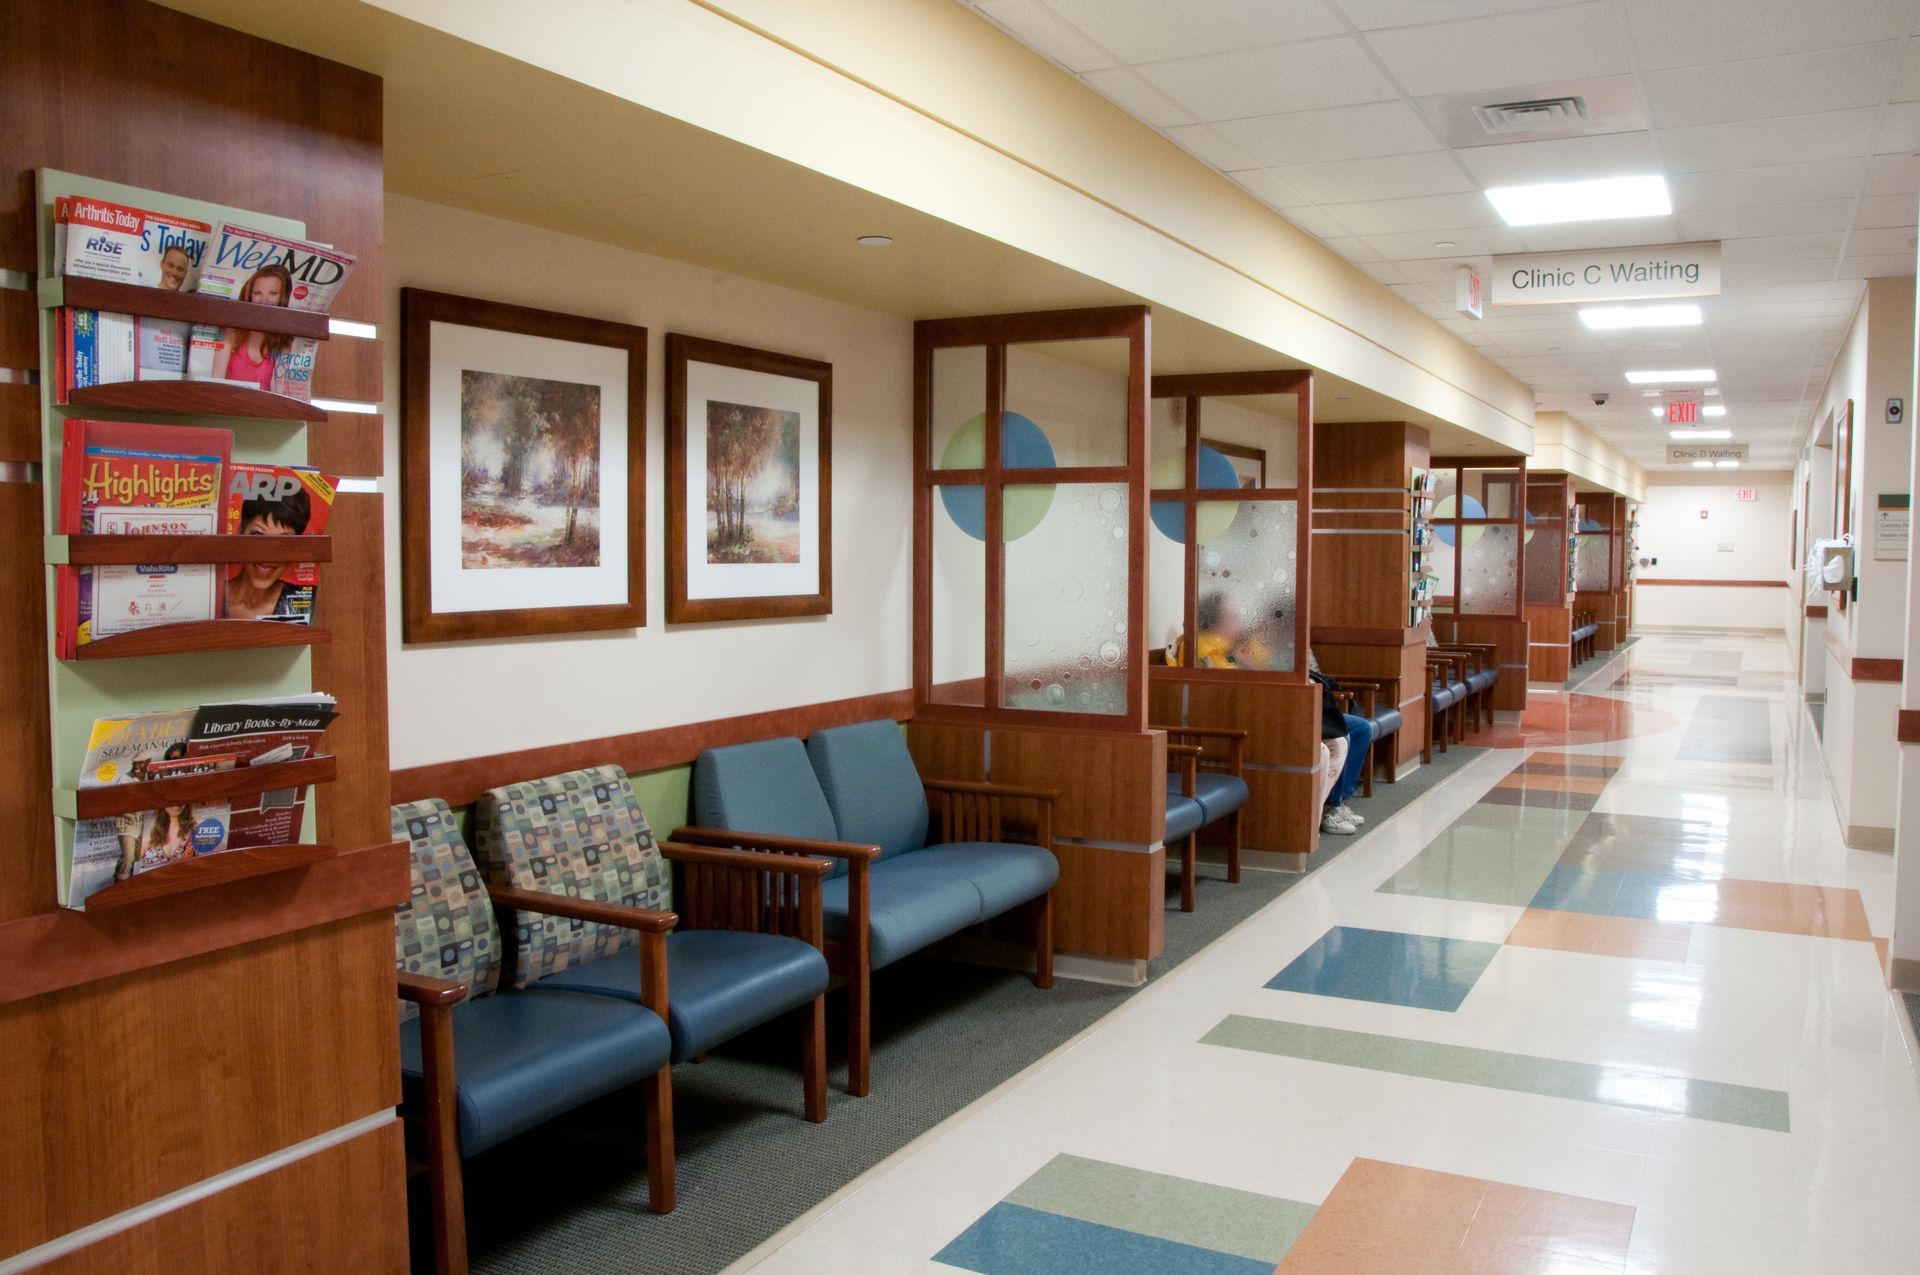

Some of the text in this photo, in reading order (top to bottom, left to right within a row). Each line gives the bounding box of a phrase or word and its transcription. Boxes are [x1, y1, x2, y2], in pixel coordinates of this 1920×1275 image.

[74, 201, 140, 233] Arthritis Today
[157, 224, 206, 268] Today
[215, 232, 345, 286] WebMD
[1511, 260, 1700, 290] Clinic C Waiting
[271, 348, 312, 368] Marcia
[274, 364, 309, 382] Cross
[1669, 401, 1697, 424] EXIT
[1673, 449, 1742, 460] Clinic D Waiting
[84, 461, 214, 505] Highlights
[1738, 489, 1752, 500] EXIT
[203, 717, 320, 735] Library Books-By-Mail
[198, 826, 220, 835] FREE
